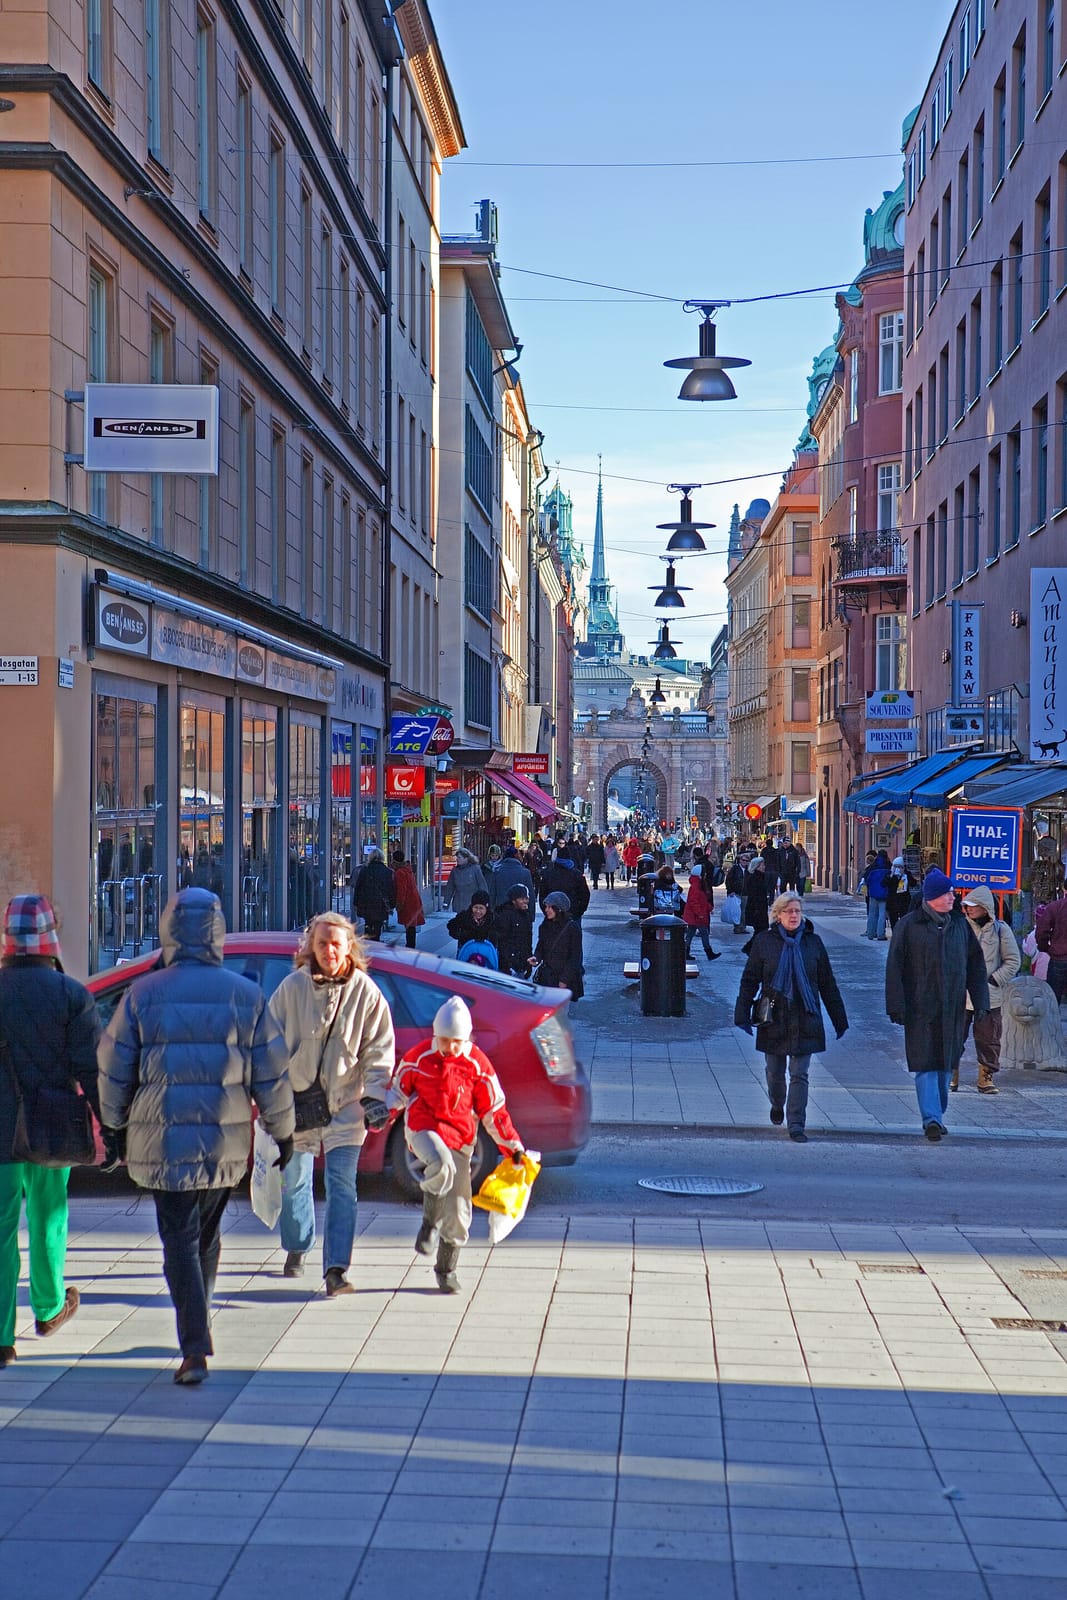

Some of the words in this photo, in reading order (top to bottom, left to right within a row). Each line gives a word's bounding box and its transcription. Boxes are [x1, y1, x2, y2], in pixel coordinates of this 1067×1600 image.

[113, 422, 187, 434] BENGANS.SE
[105, 606, 145, 638] BENGANS.SE
[963, 612, 976, 695] FARRAW
[1041, 575, 1062, 731] Amandas
[18, 673, 36, 682] 1-13
[869, 704, 912, 717] SOUVENIRS
[870, 731, 913, 743] PRESENTER
[394, 742, 421, 752] ATG
[880, 741, 903, 751] GIFTS
[966, 825, 1007, 839] THAI-
[961, 844, 1010, 860] BUFFÉ
[955, 873, 987, 883] PONG
